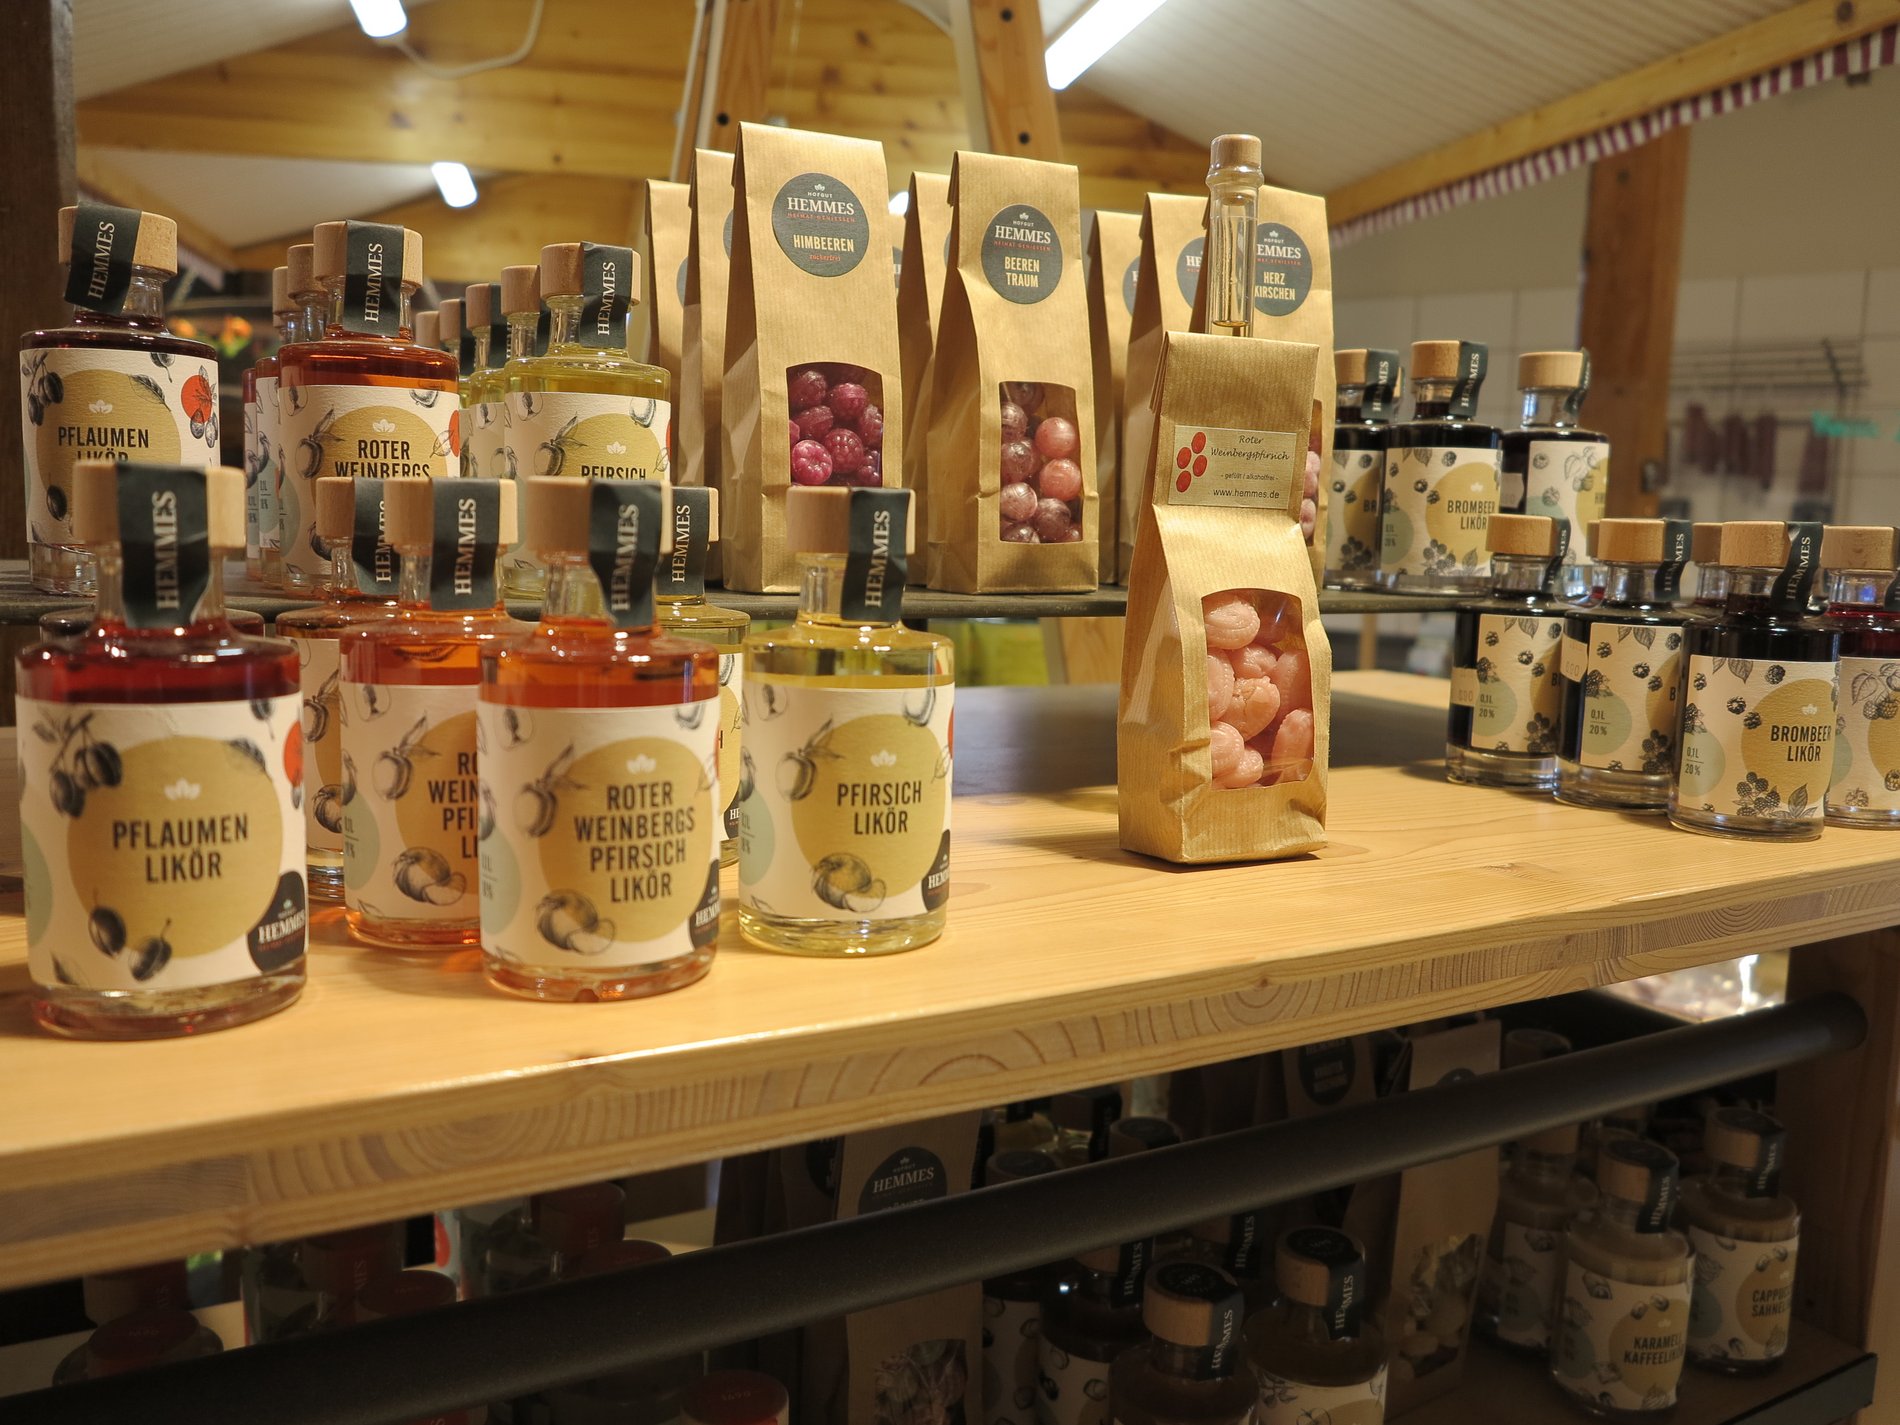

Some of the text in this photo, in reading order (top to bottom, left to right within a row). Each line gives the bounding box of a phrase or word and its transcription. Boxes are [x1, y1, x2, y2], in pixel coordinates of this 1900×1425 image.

[786, 196, 855, 216] HEMMES
[807, 191, 833, 199] HOFGUT
[793, 234, 855, 253] HIMBEEREN
[994, 225, 1052, 244] HEMMES
[88, 221, 115, 300] HEMMES
[1004, 256, 1040, 273] BEEREN
[1256, 244, 1302, 259] EMMES
[364, 243, 383, 323] HEMMES
[1005, 272, 1039, 288] TRAUM
[1263, 271, 1285, 286] HERZ
[597, 261, 616, 336] HEMMES
[1254, 285, 1296, 301] KIRSCHEN
[1461, 353, 1480, 408] HEMMES
[58, 426, 149, 448] PFLAUMEN
[358, 439, 410, 460] ROTER
[1239, 434, 1264, 445] Roter
[1211, 447, 1290, 461] Weinbergspfirsich
[1213, 488, 1280, 499] www.hemmes.de
[1447, 500, 1496, 514] BROMBEER
[1460, 515, 1487, 530] LIKÖR
[152, 490, 180, 610] HEMMES
[454, 498, 477, 596] HEMMES
[671, 504, 691, 583] HEMMES
[611, 503, 640, 612] HEMMES
[864, 510, 891, 607] HEMMES
[1786, 536, 1811, 600] HEMMES
[1770, 725, 1832, 743] BROMBEER
[1786, 743, 1821, 762] LIKÖR
[606, 781, 674, 812] ROTER
[836, 780, 922, 807] PFIRSICH
[112, 812, 249, 849] PFLAUMEN
[574, 806, 696, 843] WEINBERGS
[853, 806, 909, 836] LIKÖR
[145, 848, 223, 884] LIKÖR
[589, 838, 686, 873] PFIRSICH
[610, 870, 673, 903] LIKÖR
[871, 1166, 935, 1194] HEMMES
[1335, 1274, 1354, 1330] HEMMES
